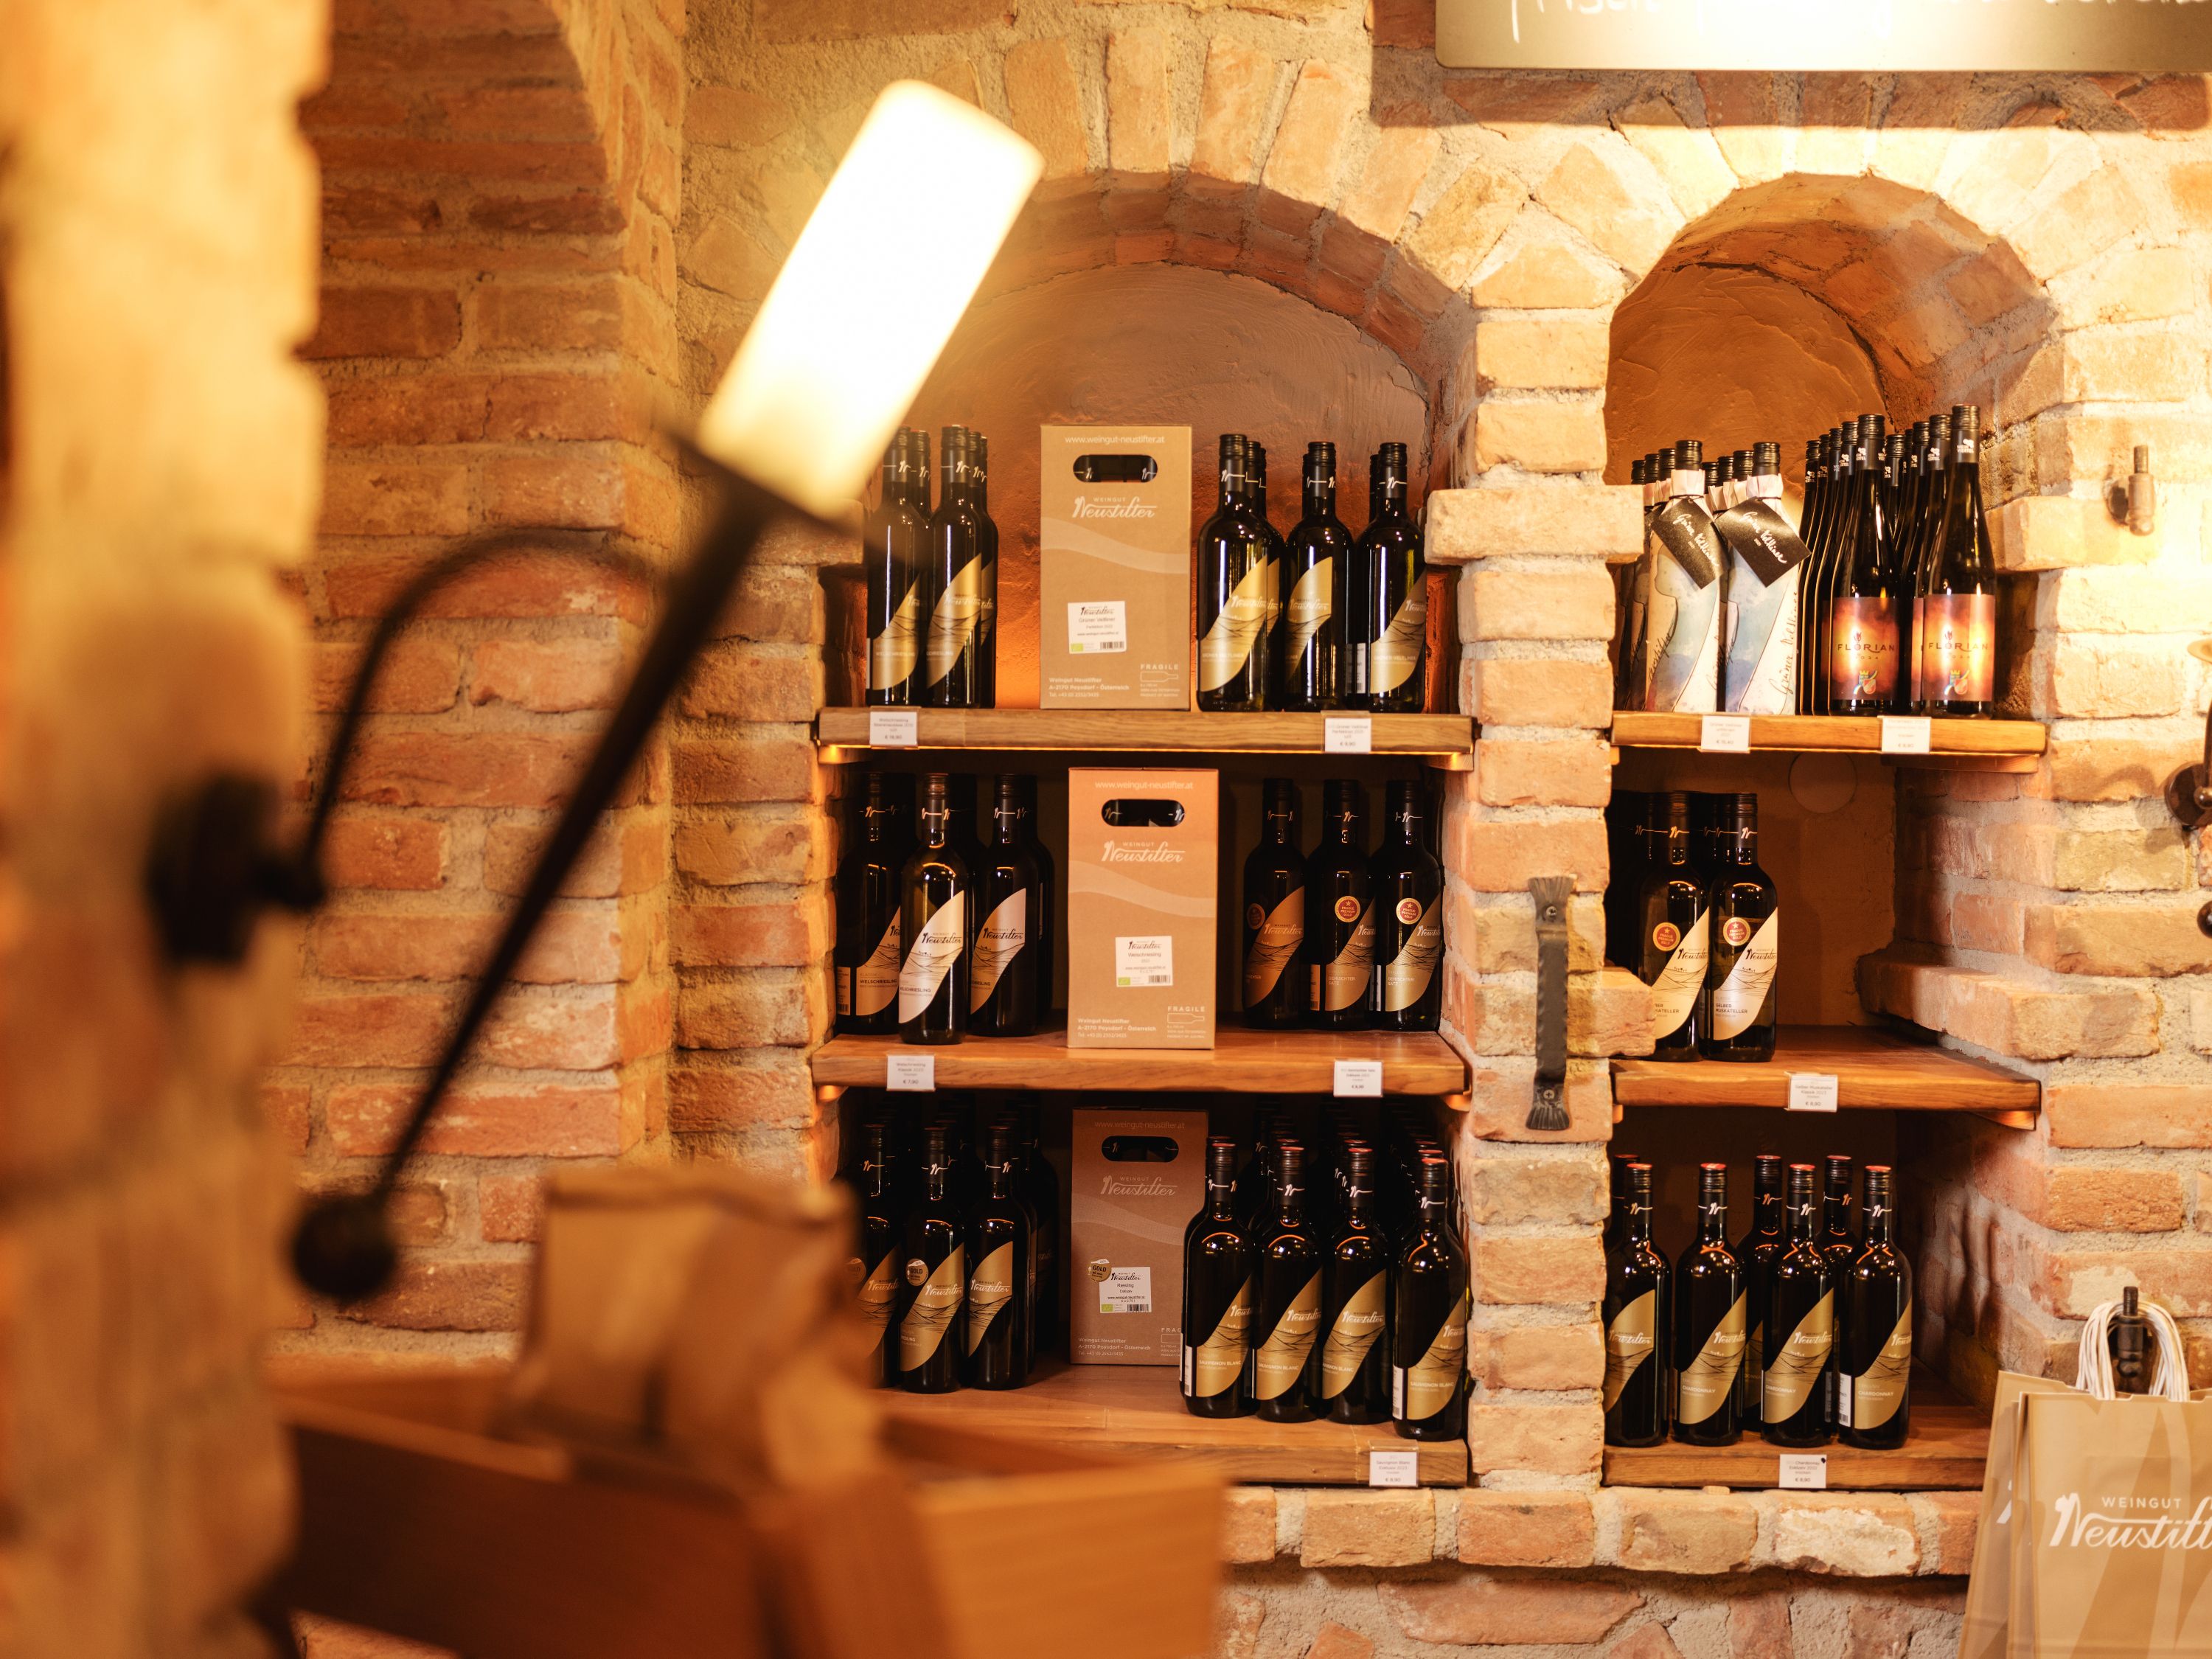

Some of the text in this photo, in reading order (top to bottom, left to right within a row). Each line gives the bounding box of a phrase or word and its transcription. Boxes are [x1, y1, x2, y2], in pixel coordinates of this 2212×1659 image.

[1065, 435, 1165, 445] www.weingut-neustifter.at
[1072, 495, 1158, 518] Neustifter
[1837, 644, 1895, 653] FLORIAN
[1928, 642, 1988, 652] FLORIAN
[1095, 781, 1193, 790] www.weingut-neustifter.at
[1102, 840, 1186, 862] Neustifter
[922, 932, 962, 944] Neustifter
[983, 928, 1024, 940] Neustifter
[1094, 1121, 1185, 1130] www.weingut-neustifter.at
[1101, 1175, 1178, 1196] Neustifter
[1111, 1272, 1141, 1281] Neustifter
[971, 1279, 1010, 1293] Neustifter
[1342, 1310, 1384, 1323] Neustifter
[1683, 1385, 1716, 1393] CHARDONNAY
[1765, 1385, 1796, 1394] CHARDONNAY
[2101, 1497, 2182, 1509] WEINGUT
